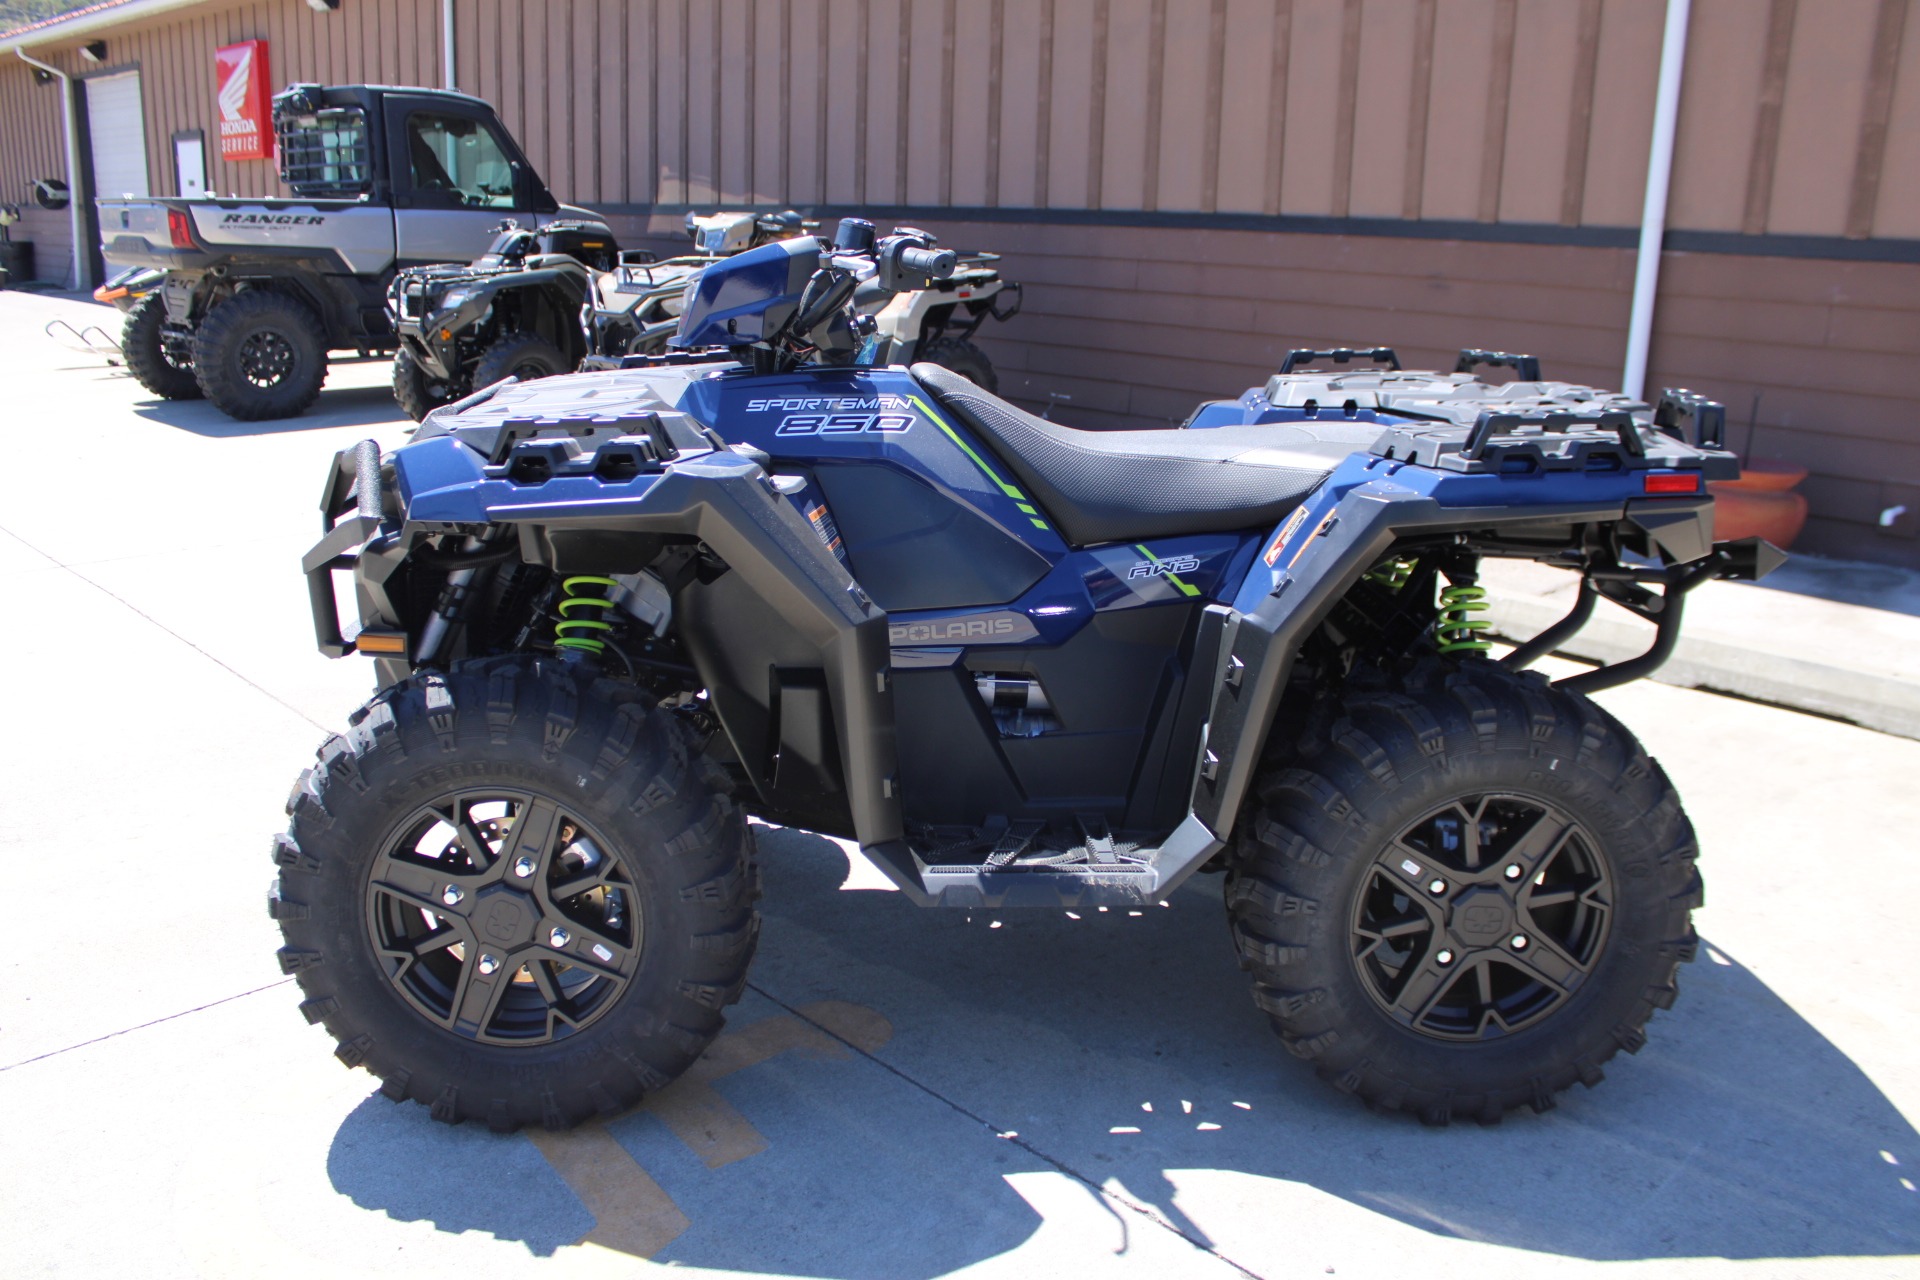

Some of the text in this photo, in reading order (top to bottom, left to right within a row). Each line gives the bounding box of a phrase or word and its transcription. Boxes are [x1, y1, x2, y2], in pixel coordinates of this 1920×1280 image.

[221, 119, 257, 136] HONDA
[222, 136, 258, 153] SERVICE
[223, 213, 325, 226] RANGER
[745, 397, 913, 412] SPORTSMAN
[774, 413, 917, 437] 850
[1127, 558, 1200, 580] AWD
[889, 618, 1014, 643] POLARIS
